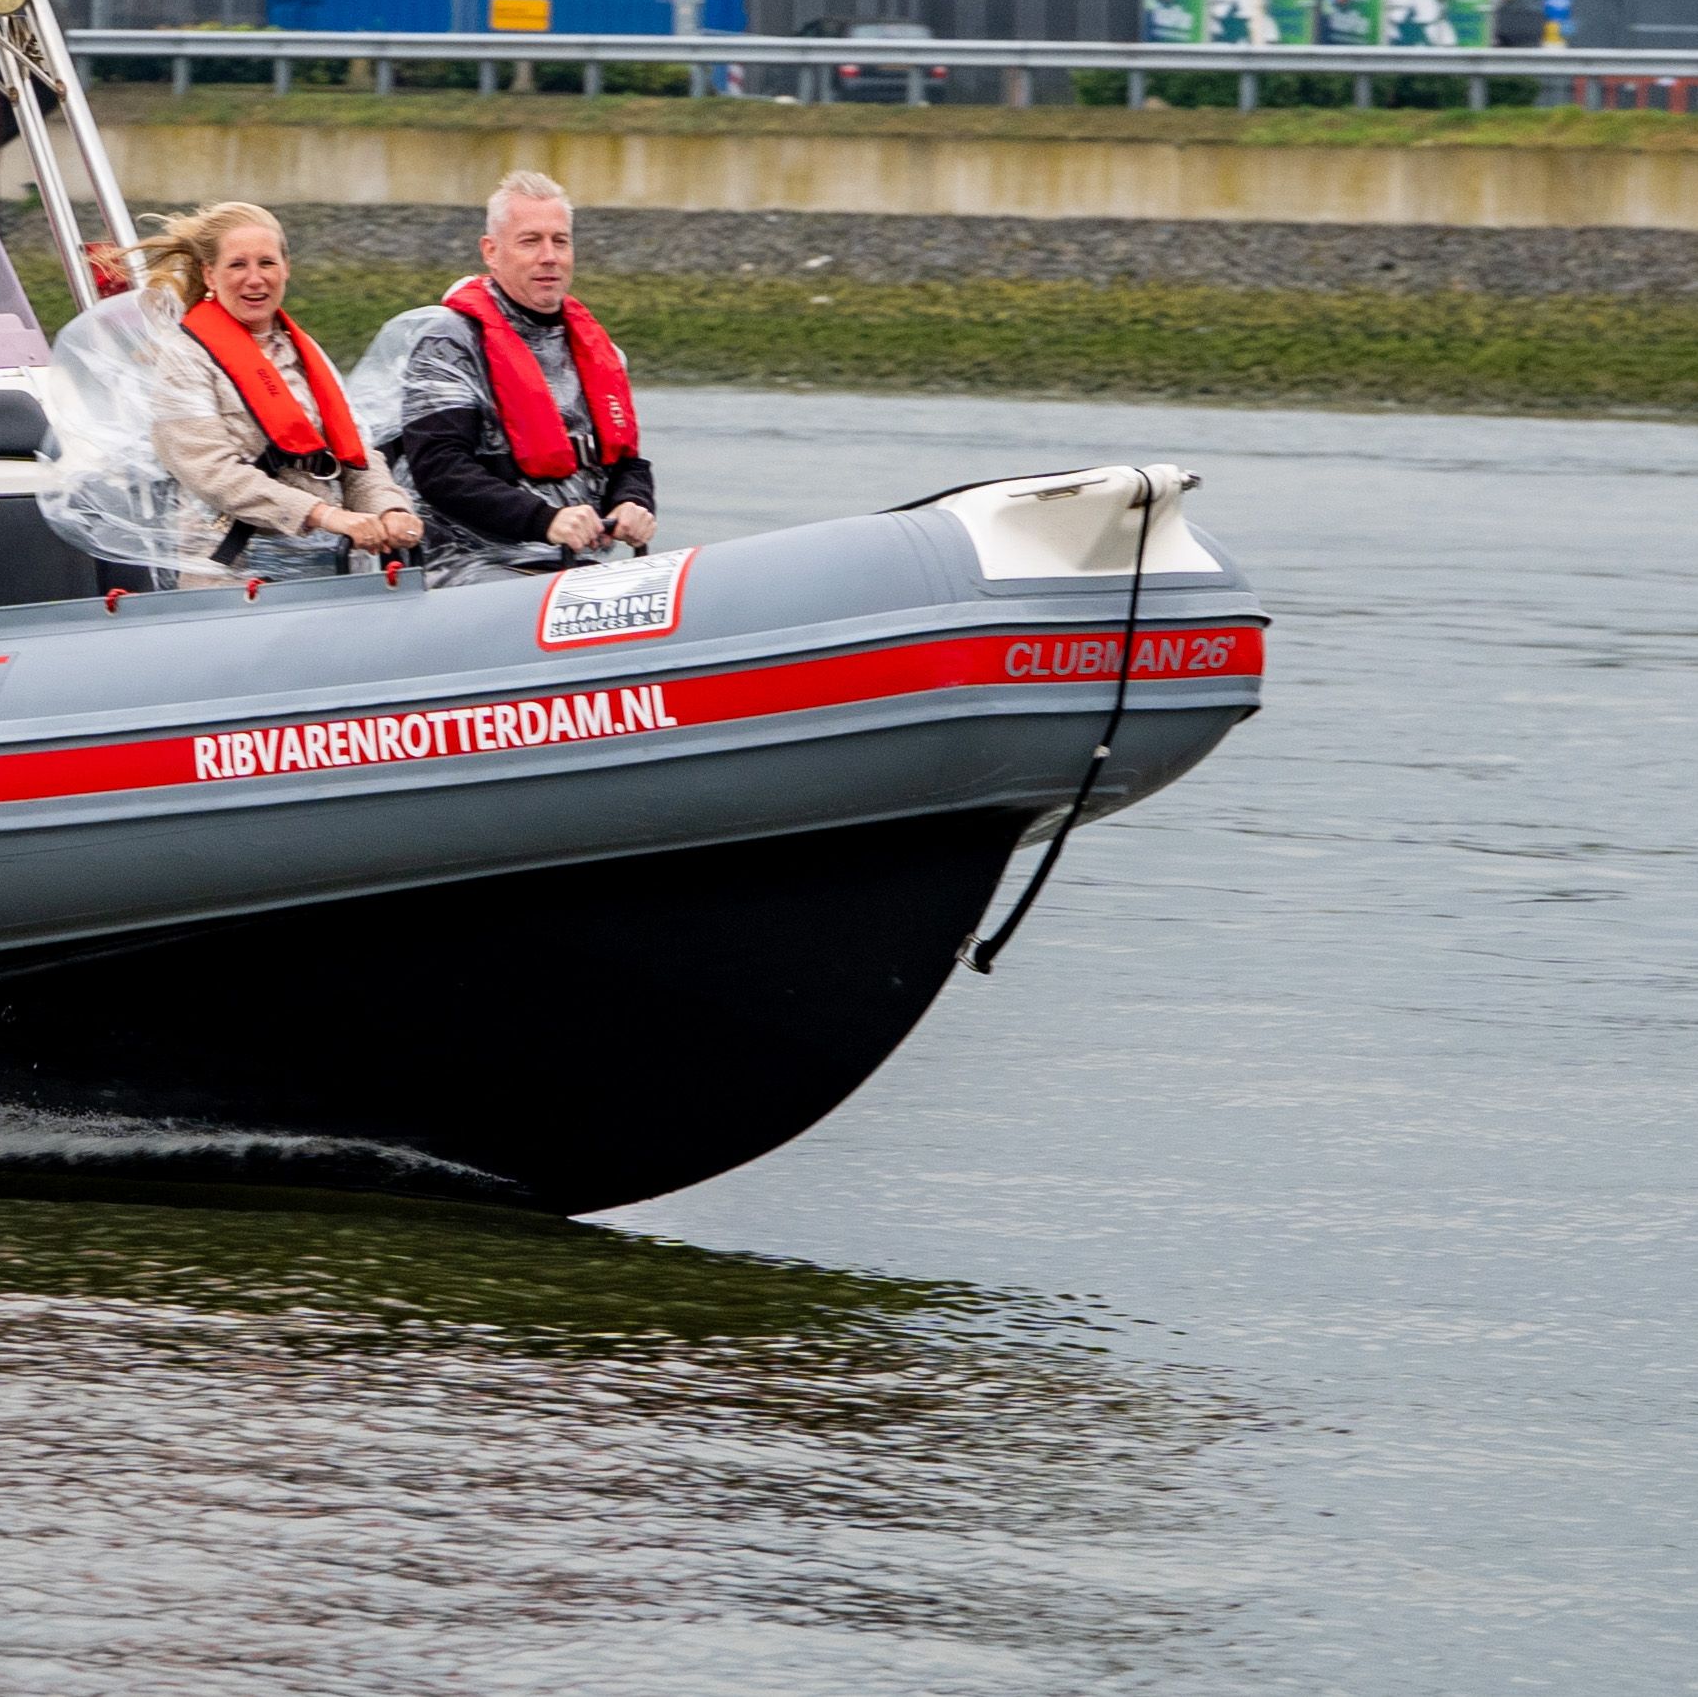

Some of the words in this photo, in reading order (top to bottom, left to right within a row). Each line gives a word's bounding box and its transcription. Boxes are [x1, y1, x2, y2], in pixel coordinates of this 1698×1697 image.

[549, 614, 629, 638] SERVICES
[553, 592, 668, 625] MARINE
[1004, 637, 1186, 678] CLUBMAN
[193, 684, 678, 780] RIBVARENROTTERDAM.NL
